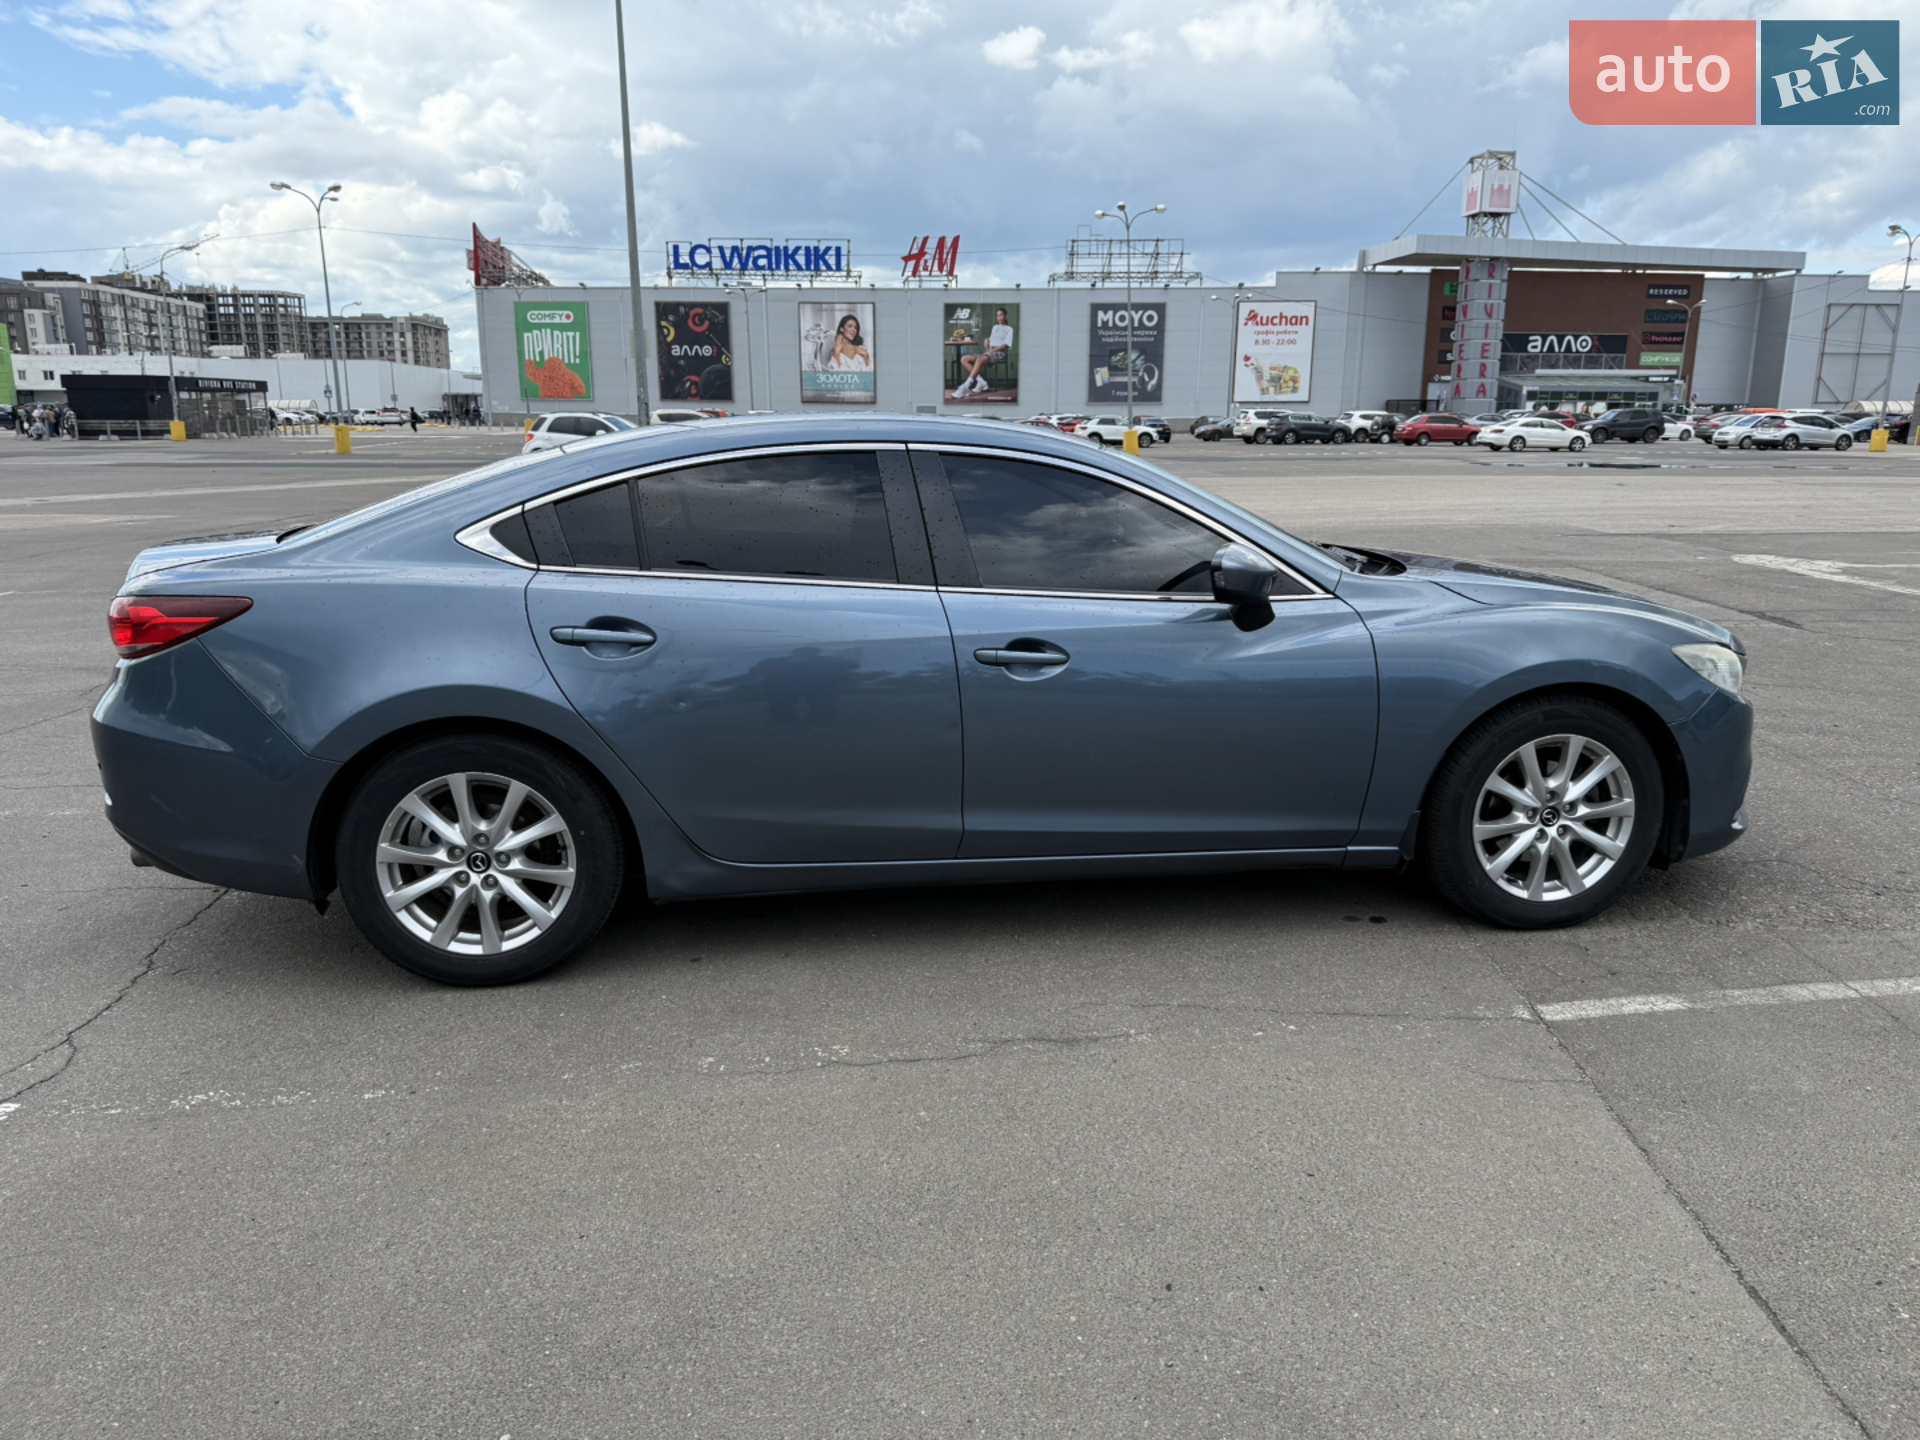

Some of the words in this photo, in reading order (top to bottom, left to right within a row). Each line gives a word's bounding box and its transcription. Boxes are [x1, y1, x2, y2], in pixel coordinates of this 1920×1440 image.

[672, 244, 713, 270] LC
[900, 234, 961, 278] H&M
[1649, 288, 1688, 296] RESERVED
[529, 312, 565, 321] COMFY
[1097, 310, 1159, 328] MOYO
[1244, 309, 1309, 326] Auchan
[1476, 263, 1496, 398] RIVIERA
[523, 328, 580, 364] ПРИВІТ!
[1276, 338, 1297, 346] 22:00
[816, 373, 860, 384] ЗОЛОТА
